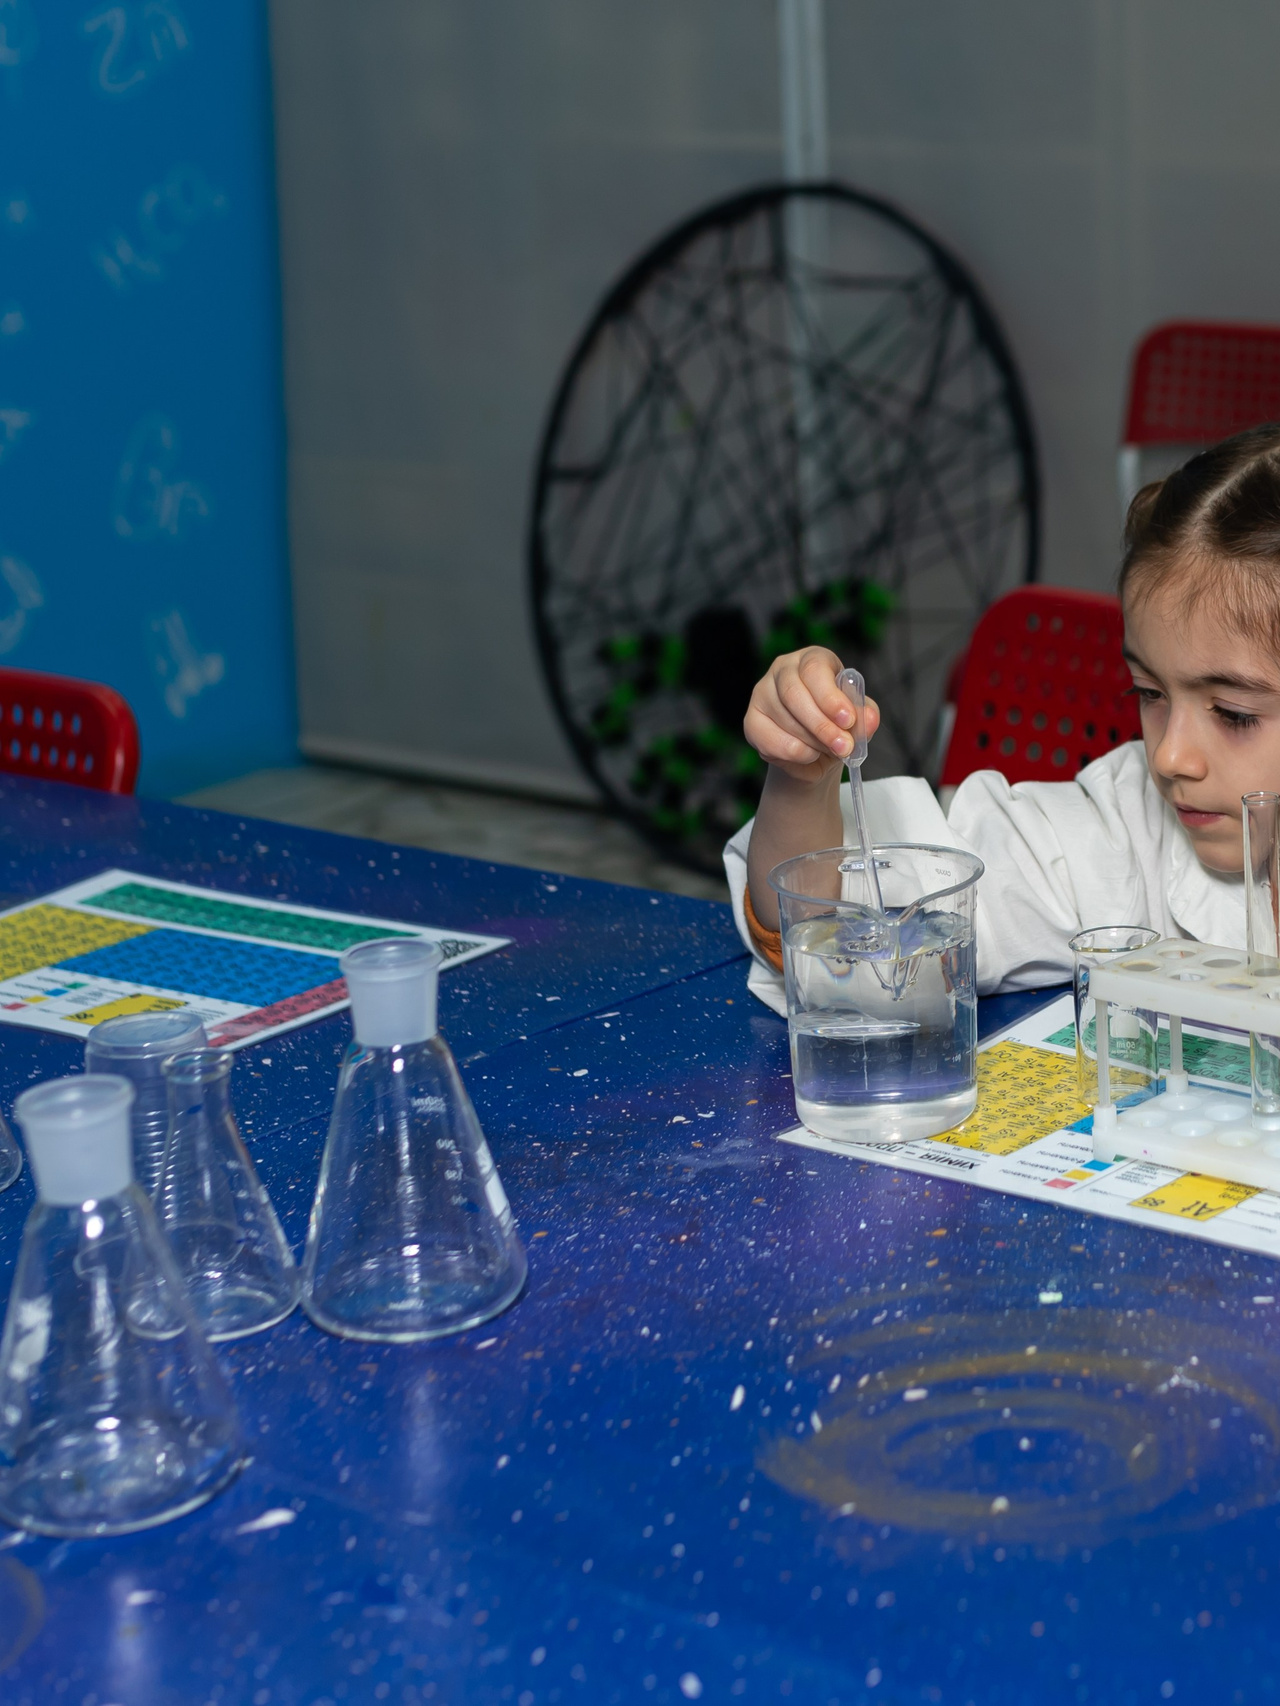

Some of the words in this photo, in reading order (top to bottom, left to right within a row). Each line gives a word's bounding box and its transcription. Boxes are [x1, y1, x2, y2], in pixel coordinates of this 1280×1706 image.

[994, 1050, 1012, 1059] Og
[919, 1152, 980, 1171] ХИМИЯ
[1138, 1197, 1165, 1207] 85
[1180, 1200, 1226, 1217] At
